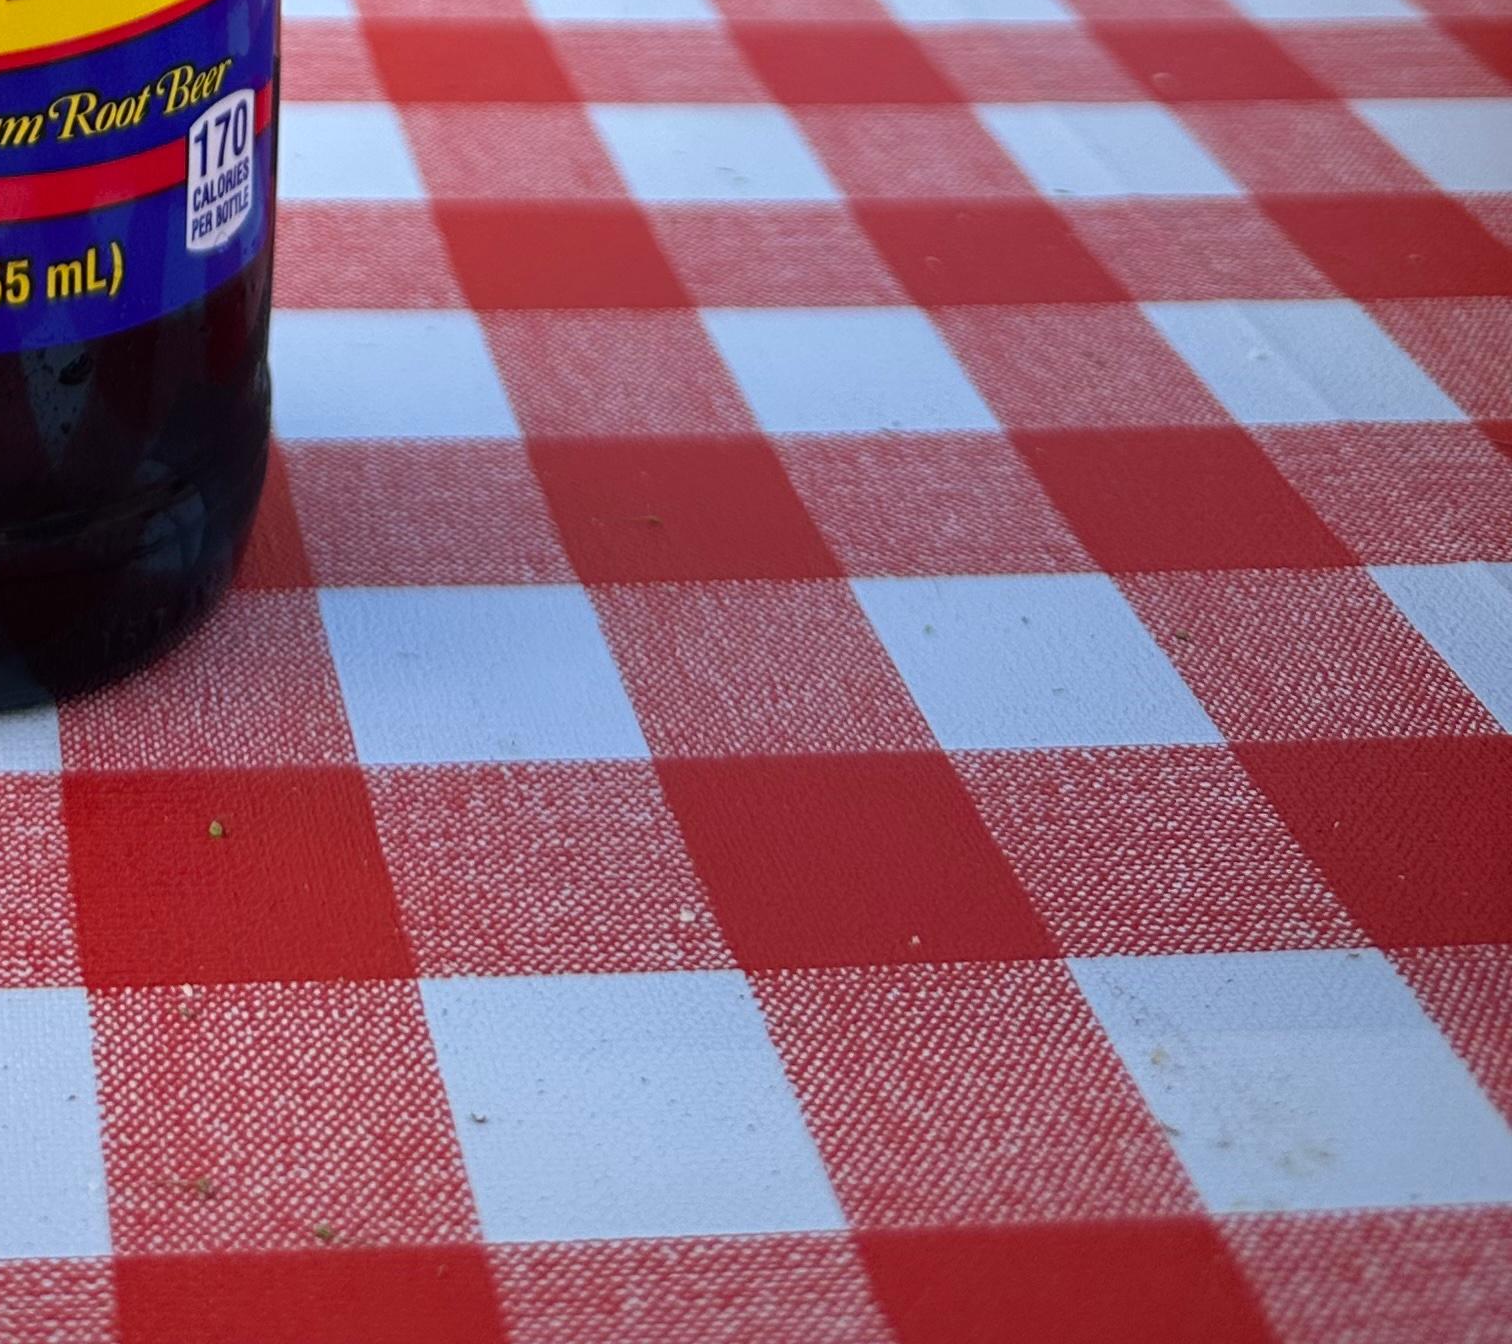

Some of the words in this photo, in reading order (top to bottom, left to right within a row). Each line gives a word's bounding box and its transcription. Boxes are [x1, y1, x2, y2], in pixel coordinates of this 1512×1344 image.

[48, 84, 151, 140] Root
[156, 58, 233, 114] Beer
[194, 98, 248, 178] 170
[191, 210, 213, 242] PER
[215, 183, 249, 229] BOTTLE
[192, 156, 250, 213] CALORIES
[46, 241, 123, 299] mL)
